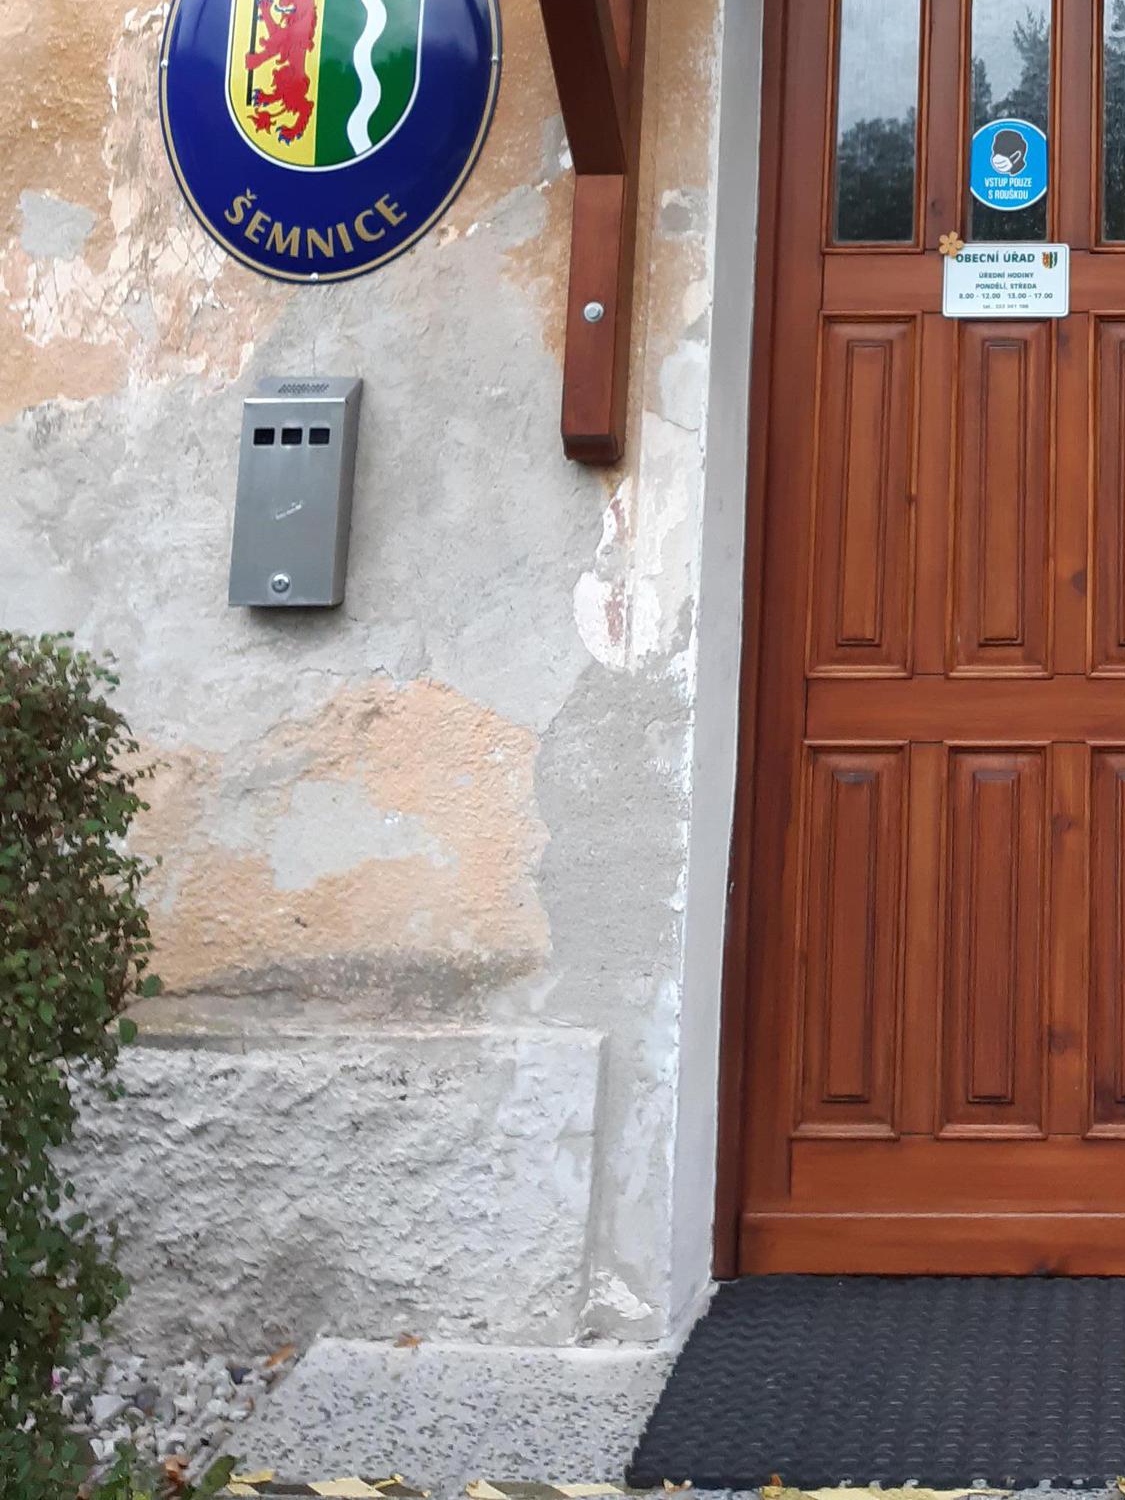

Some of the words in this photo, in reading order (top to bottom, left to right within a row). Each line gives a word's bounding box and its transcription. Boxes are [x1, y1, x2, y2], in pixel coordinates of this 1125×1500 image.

[984, 177, 1008, 188] VSTUP
[1009, 177, 1032, 188] POUZE
[988, 189, 993, 200] S
[994, 188, 1029, 200] ROUŠKOU
[224, 187, 407, 260] ŠEMNICE
[955, 250, 999, 263] OBECNÍ
[1003, 250, 1036, 263] ÚŘAD
